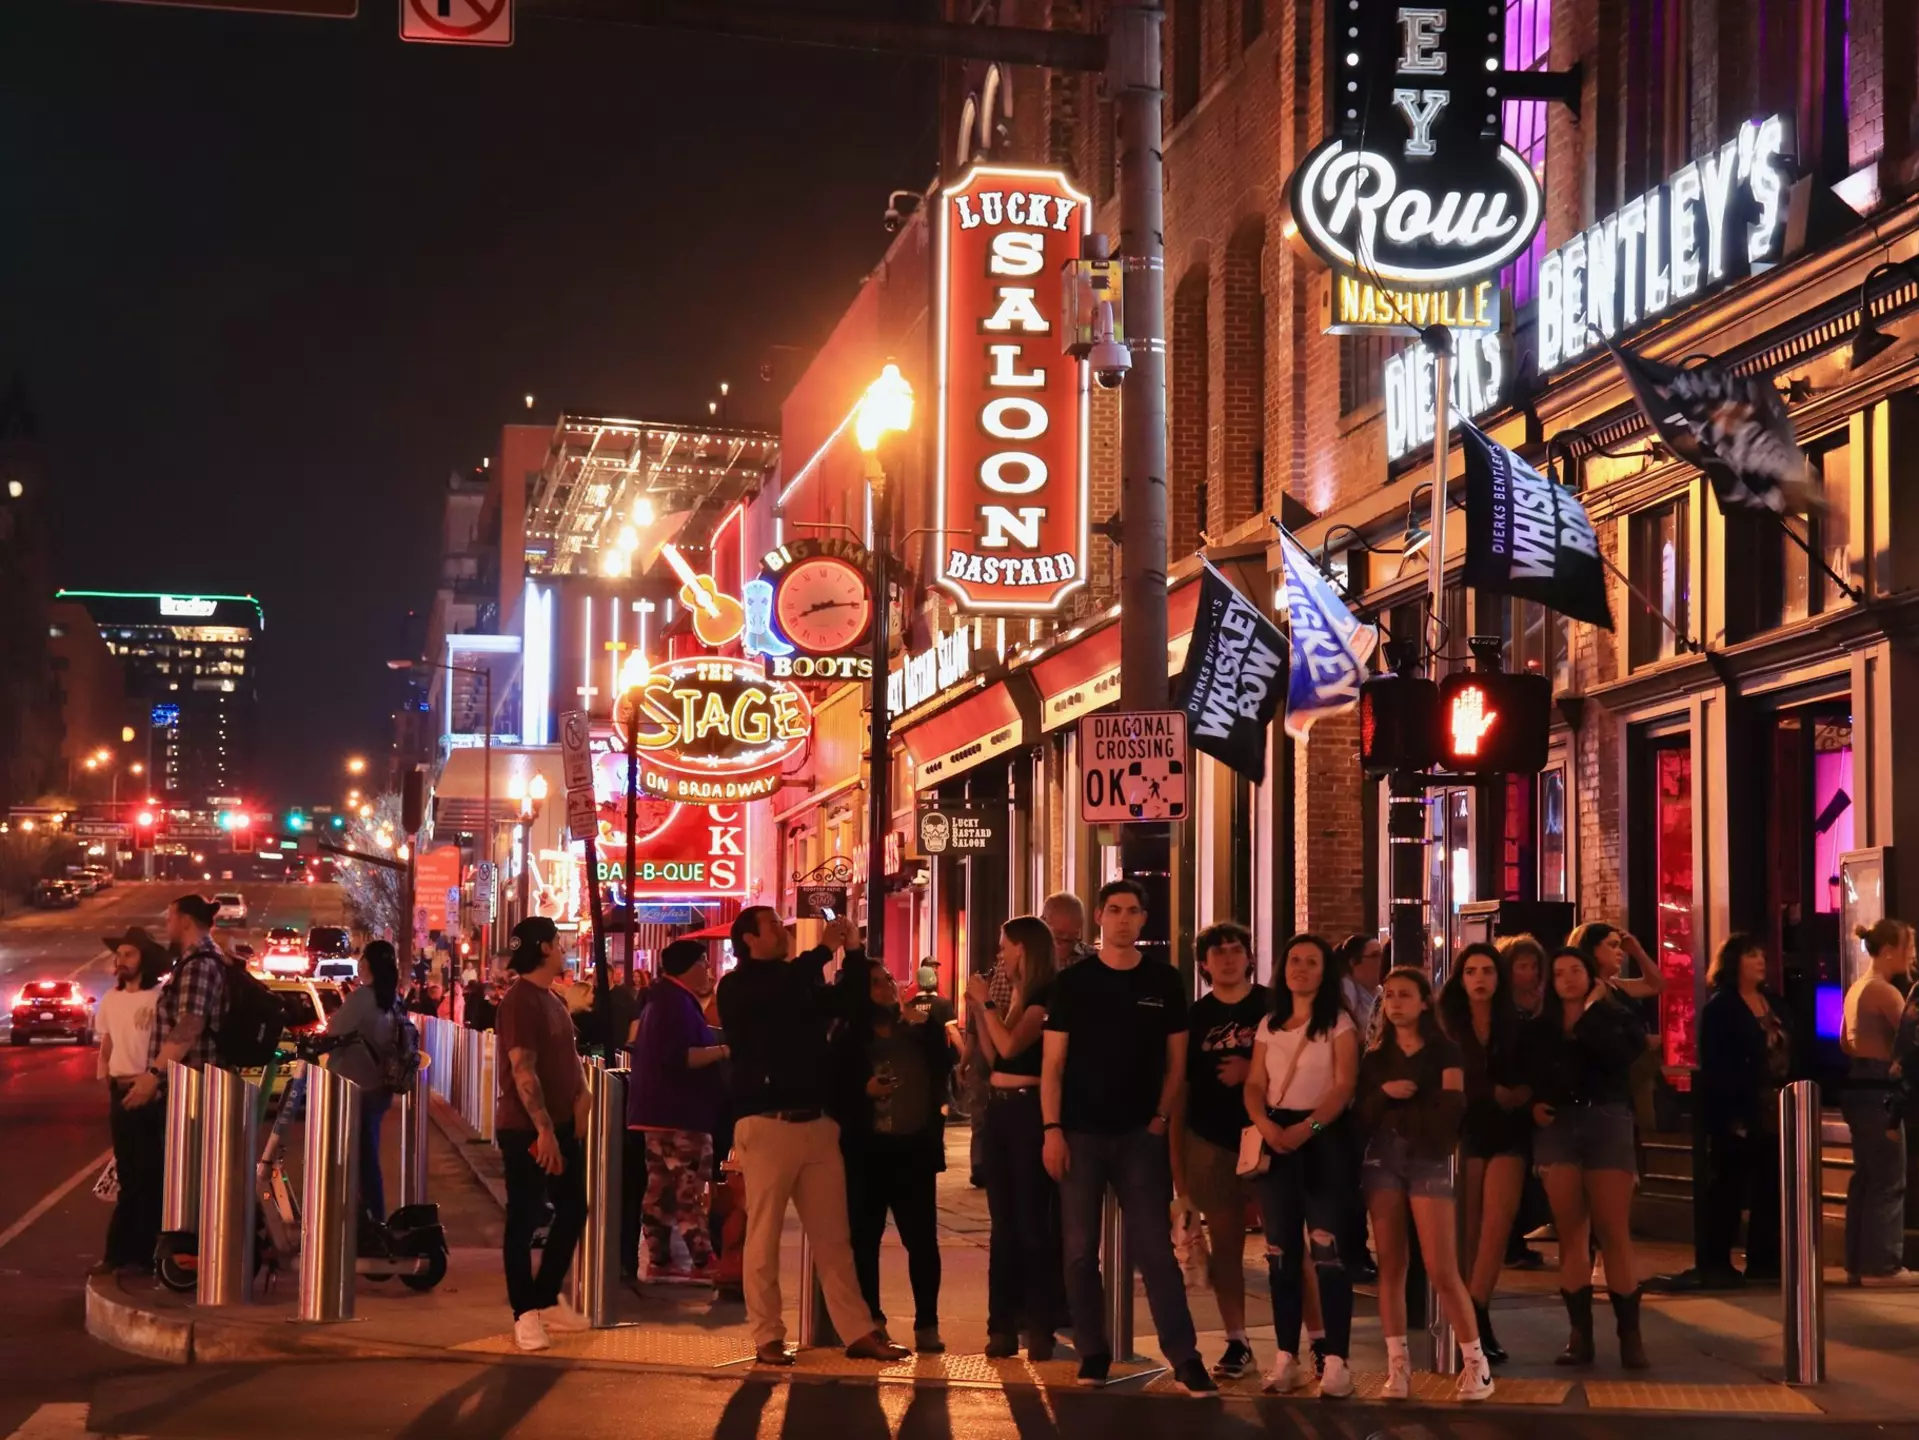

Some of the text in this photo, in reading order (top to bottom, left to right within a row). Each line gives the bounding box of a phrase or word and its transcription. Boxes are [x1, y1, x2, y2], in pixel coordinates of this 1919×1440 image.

[955, 191, 1077, 232] LUCKY
[1321, 151, 1518, 262] Row
[1538, 114, 1783, 377] BENTLEY'S
[1340, 274, 1493, 326] NASHVILLE
[980, 231, 1050, 551] SALOON
[1491, 504, 1507, 554] DIERKS
[764, 541, 809, 572] BIG
[946, 550, 1077, 586] BASTARD
[1284, 562, 1360, 704] HISKEY
[697, 663, 733, 682] THE
[772, 656, 873, 678] BOOTS
[1193, 590, 1261, 741] WHISKEY
[1236, 636, 1283, 722] ROW
[1188, 666, 1211, 712] DIERKS
[636, 674, 806, 750] STAGE
[1094, 716, 1175, 738] DIAGONAL
[1095, 738, 1175, 760] CROSSING
[646, 772, 776, 799] ON BROADWAY
[1086, 768, 1127, 808] OK
[952, 817, 980, 828] LUCKY
[952, 827, 992, 838] BASTARD
[952, 837, 986, 848] SALOON
[596, 862, 705, 881] BA-B-QUE
